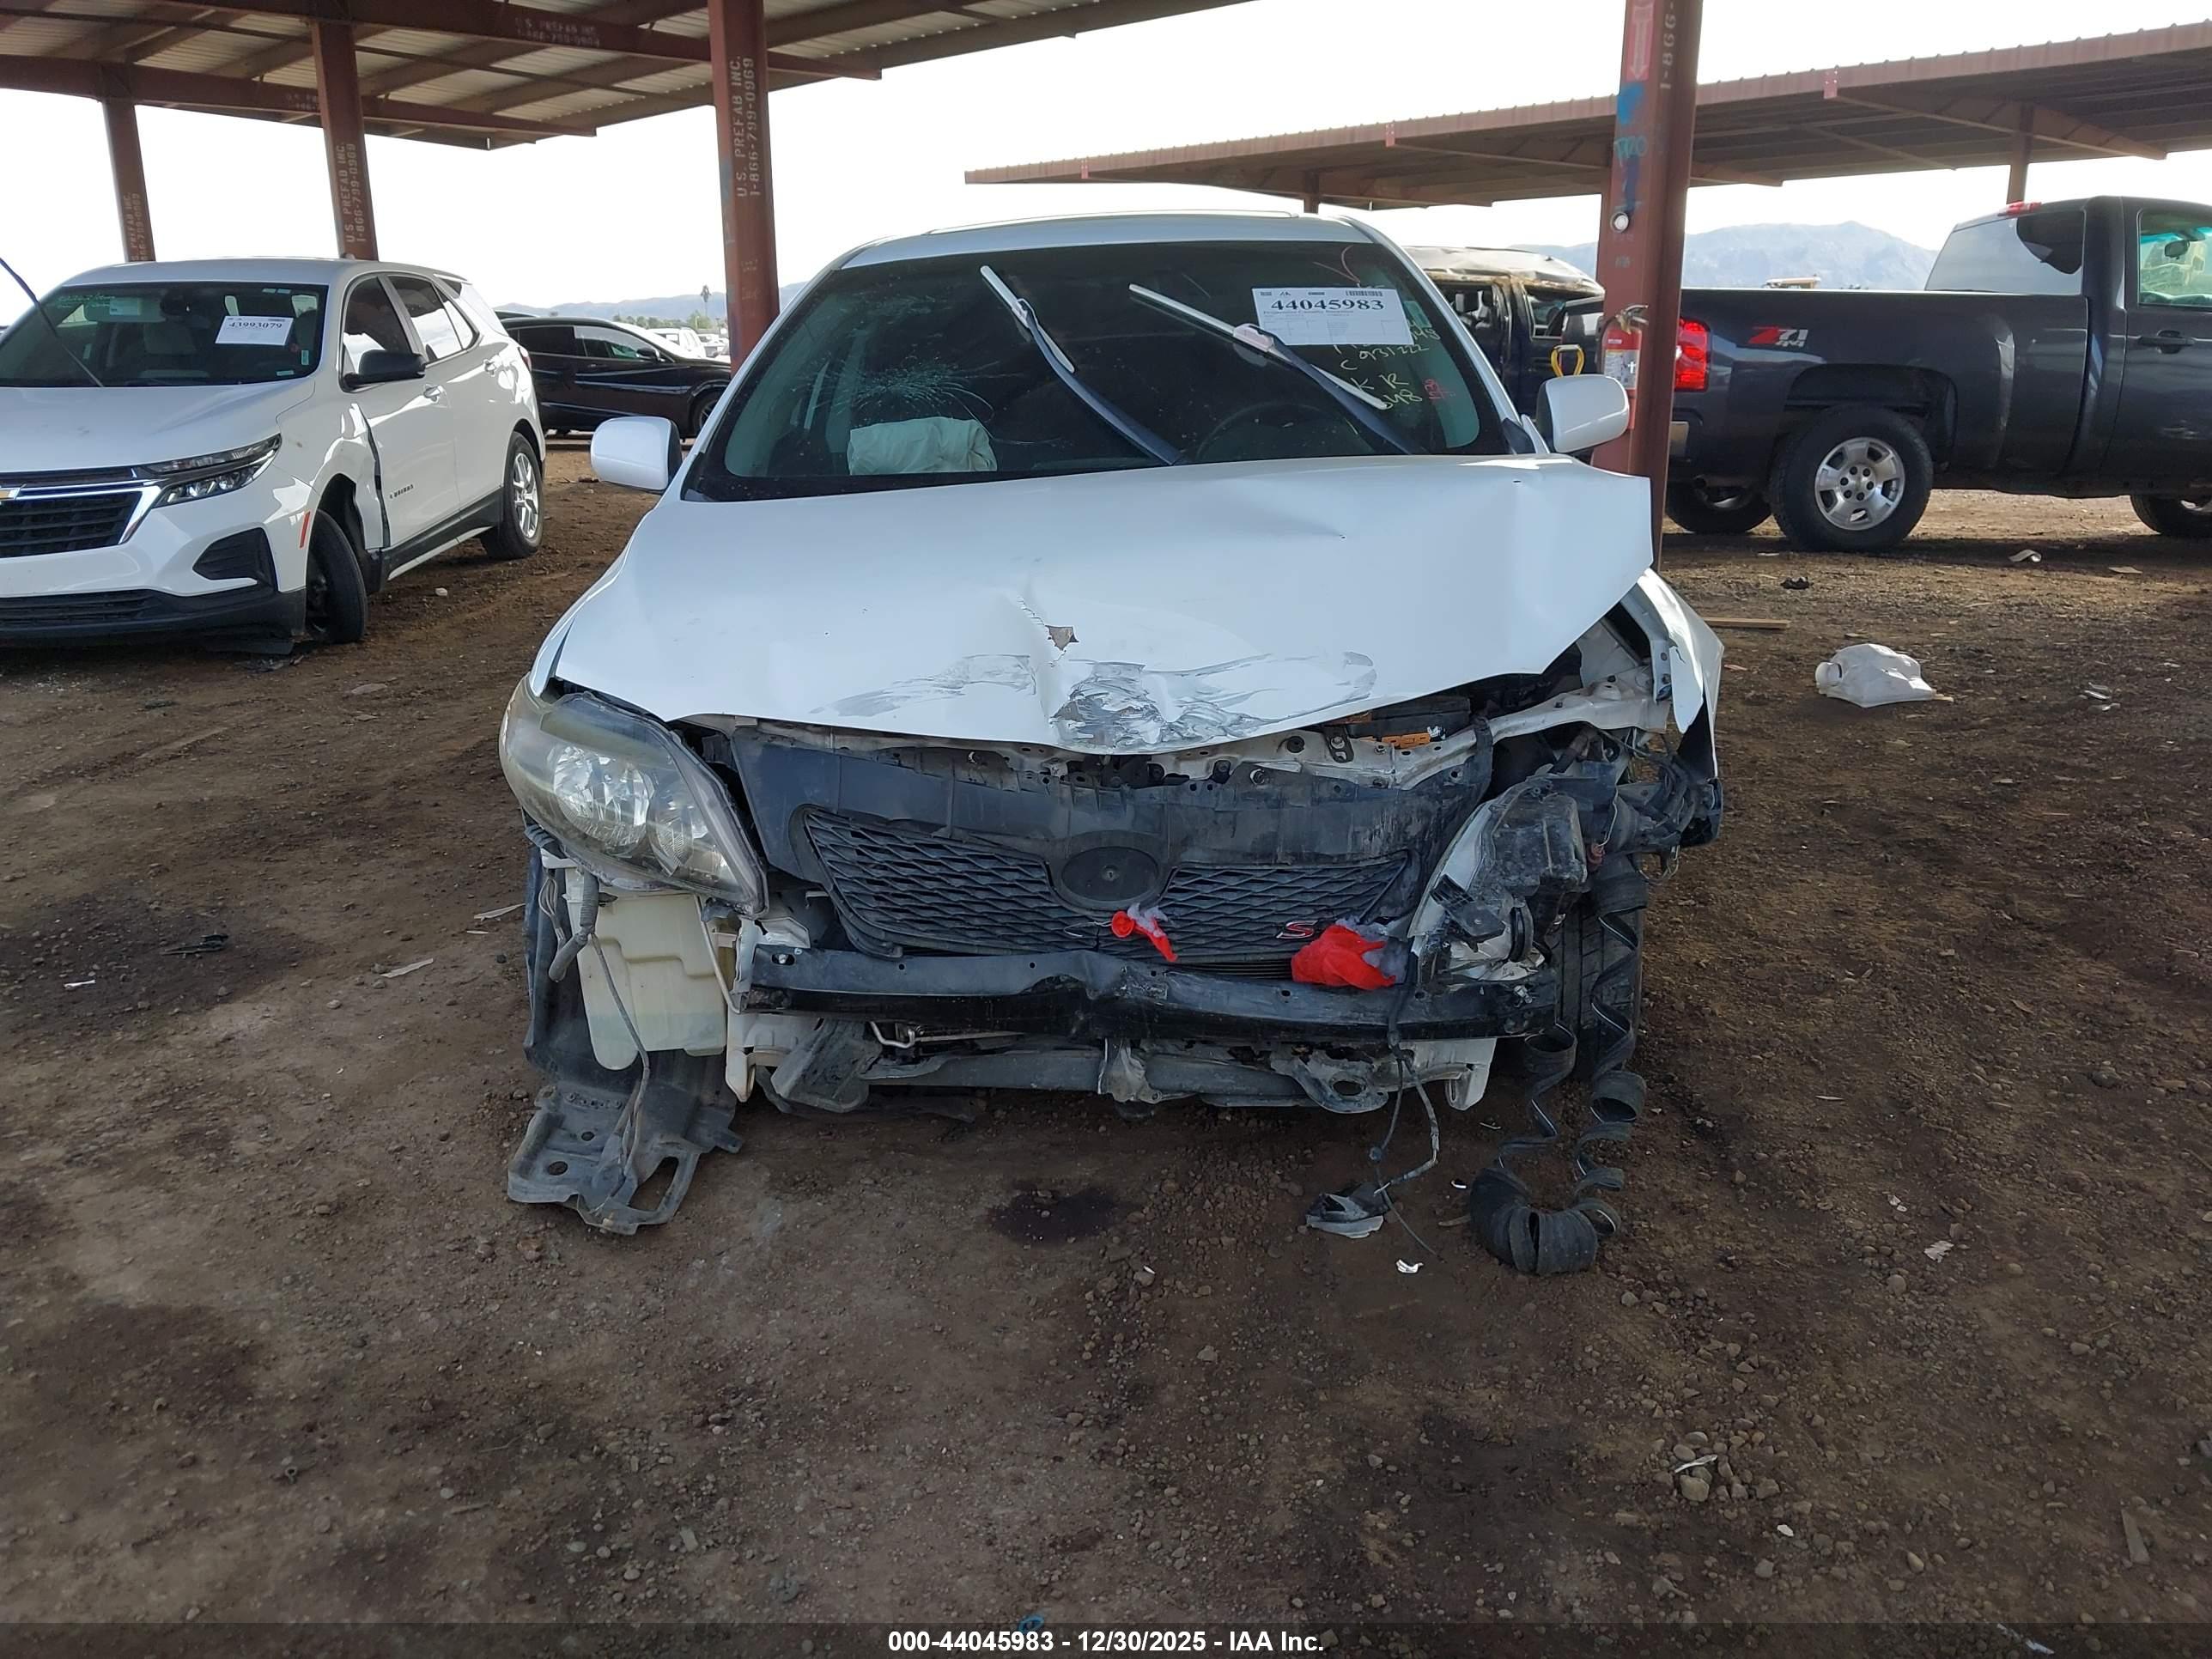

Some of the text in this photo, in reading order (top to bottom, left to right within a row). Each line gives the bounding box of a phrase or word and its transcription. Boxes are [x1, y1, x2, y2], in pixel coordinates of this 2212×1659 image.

[730, 56, 747, 198] U.S. PREFAB INC.
[743, 57, 761, 197] 1-866-799-0969
[340, 169, 352, 215] PREFAB
[1271, 299, 1384, 311] 44045983
[1746, 325, 1808, 344] Z71
[1276, 920, 1318, 939] S
